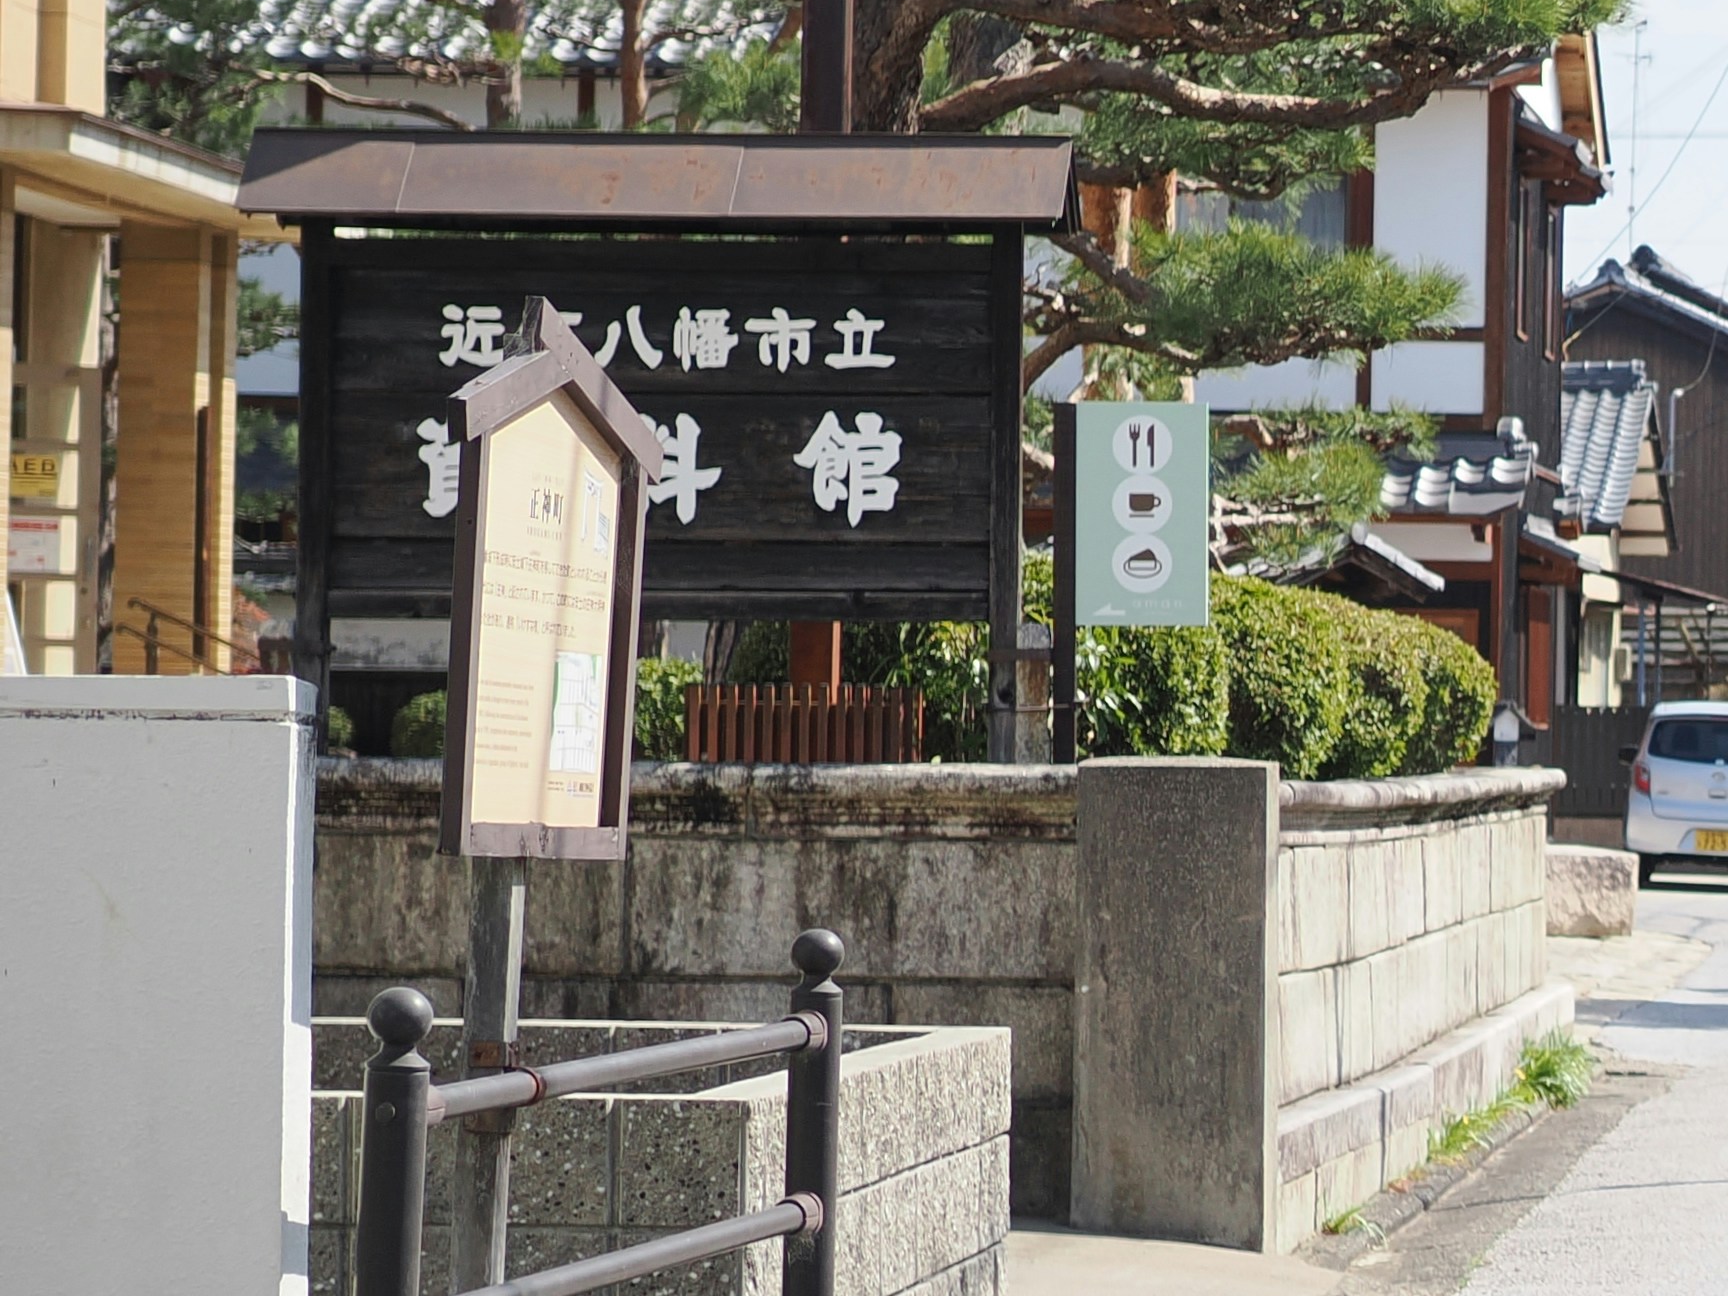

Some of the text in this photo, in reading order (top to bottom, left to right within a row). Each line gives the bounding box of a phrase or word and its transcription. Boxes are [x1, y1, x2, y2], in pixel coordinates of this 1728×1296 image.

[438, 304, 896, 373] 近八幡市立
